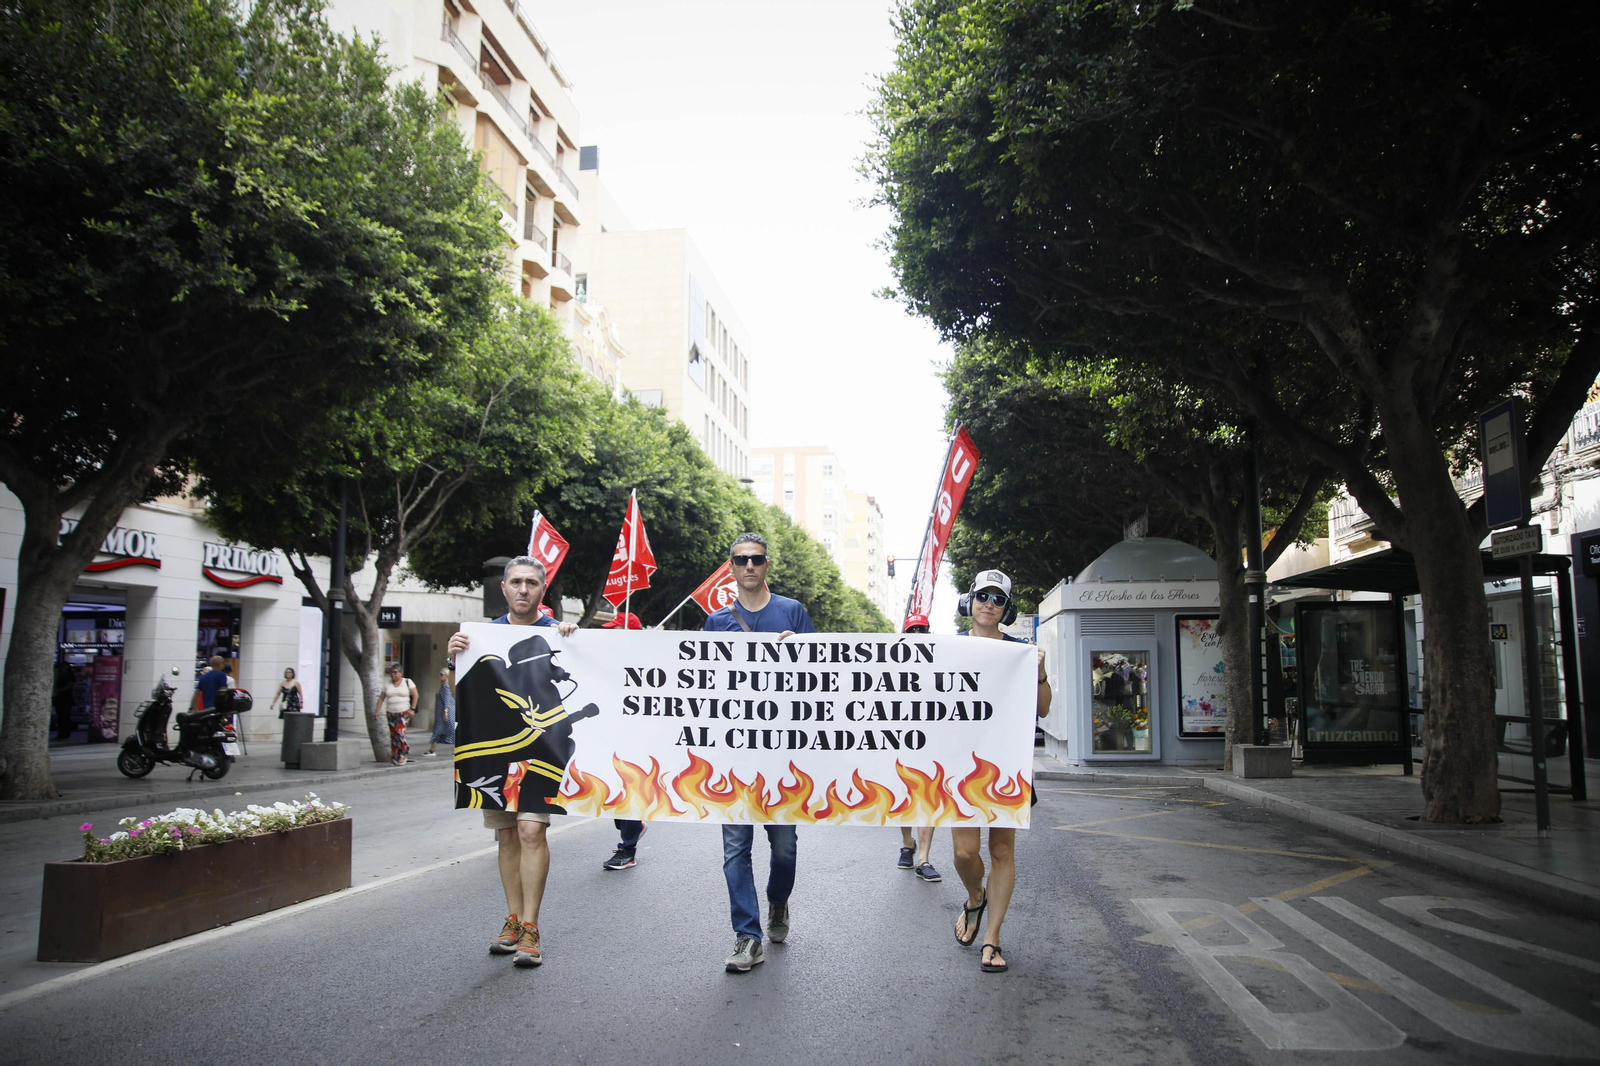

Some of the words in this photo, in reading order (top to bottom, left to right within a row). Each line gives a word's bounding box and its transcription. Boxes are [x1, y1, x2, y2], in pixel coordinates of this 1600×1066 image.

[56, 518, 161, 560] PMOR
[538, 530, 560, 564] U
[1493, 531, 1524, 545] AUTORIZADO
[1524, 529, 1536, 539] TAXI
[203, 542, 282, 577] PRIMOR
[1079, 590, 1093, 603] El
[1094, 589, 1133, 603] Kiosko
[1135, 590, 1148, 601] de
[1150, 589, 1165, 600] las
[1167, 588, 1200, 601] Flores
[678, 640, 735, 663] SIN
[746, 638, 936, 664] INVERSIÓN
[623, 667, 667, 689] NO
[677, 668, 716, 690] SE
[727, 670, 840, 693] PUEDE
[851, 671, 922, 693] DAR
[933, 671, 981, 693] UN
[622, 695, 779, 722] SERVICIO
[790, 700, 834, 722] DE
[845, 700, 993, 722] CALIDAD
[675, 726, 716, 748] AL
[725, 728, 926, 750] CIUDADANO
